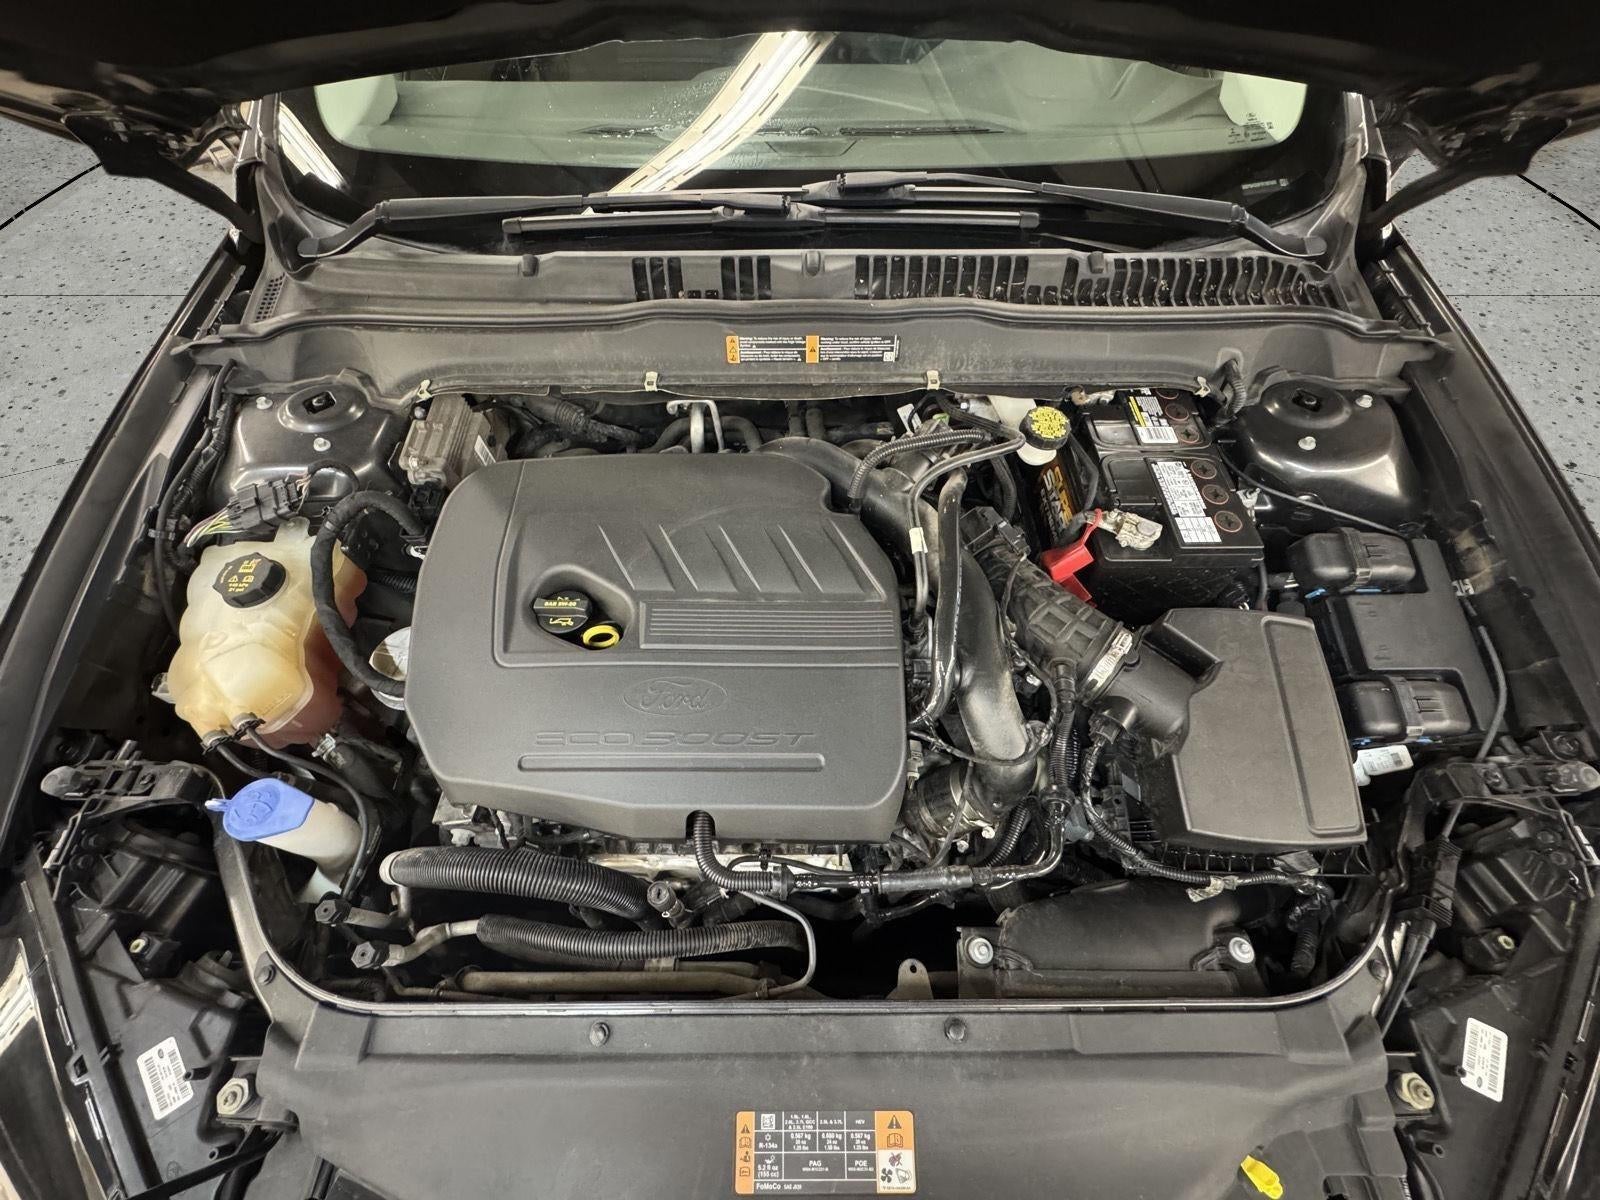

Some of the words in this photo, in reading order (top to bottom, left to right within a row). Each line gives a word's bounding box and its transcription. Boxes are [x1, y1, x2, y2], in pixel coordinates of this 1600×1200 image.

[1043, 468, 1066, 531] STAR
[1054, 466, 1072, 528] SUPE
[641, 679, 711, 711] Ford
